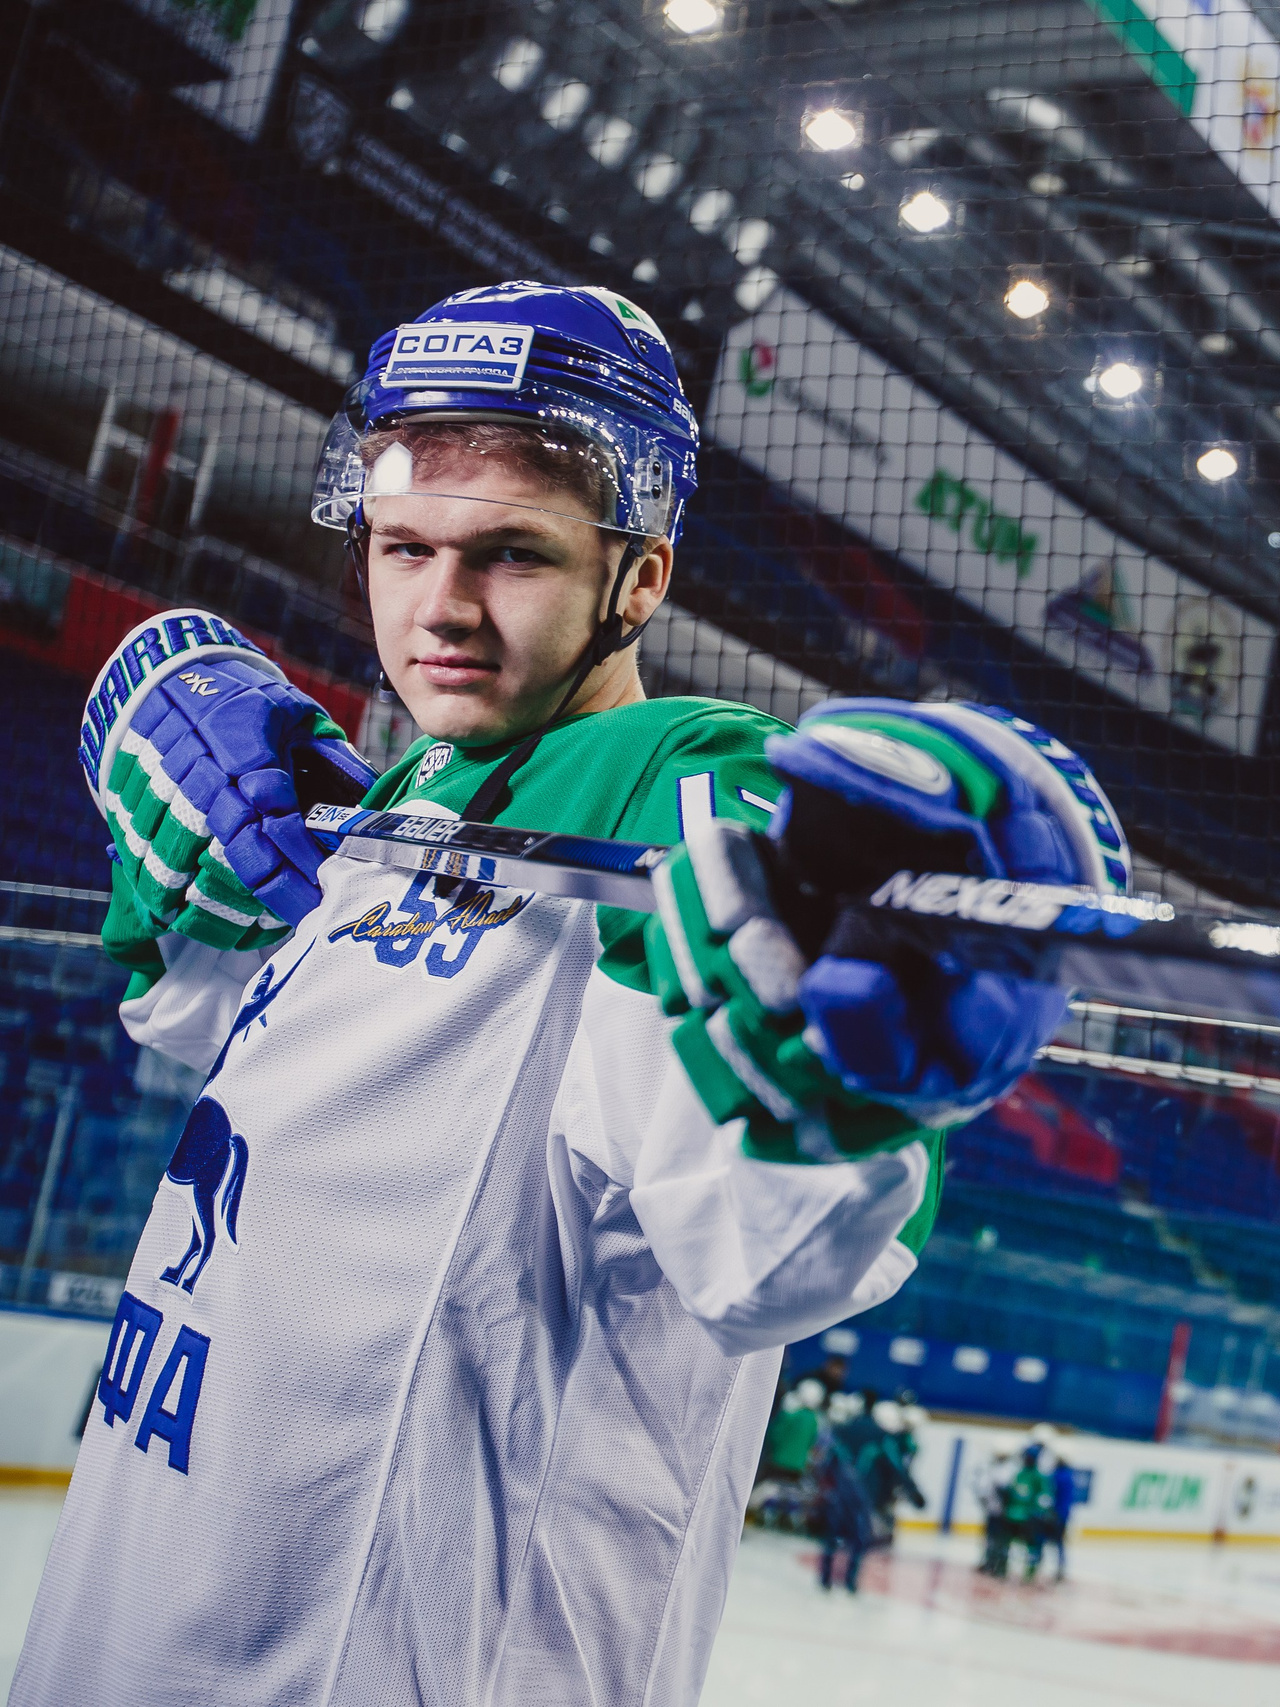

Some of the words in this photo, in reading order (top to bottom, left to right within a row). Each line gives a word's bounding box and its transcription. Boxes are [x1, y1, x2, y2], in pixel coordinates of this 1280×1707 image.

[398, 333, 525, 356] СОГАЗ
[392, 816, 467, 843] BAUER
[869, 869, 1064, 931] NEXUS
[98, 1290, 212, 1476] ФА
